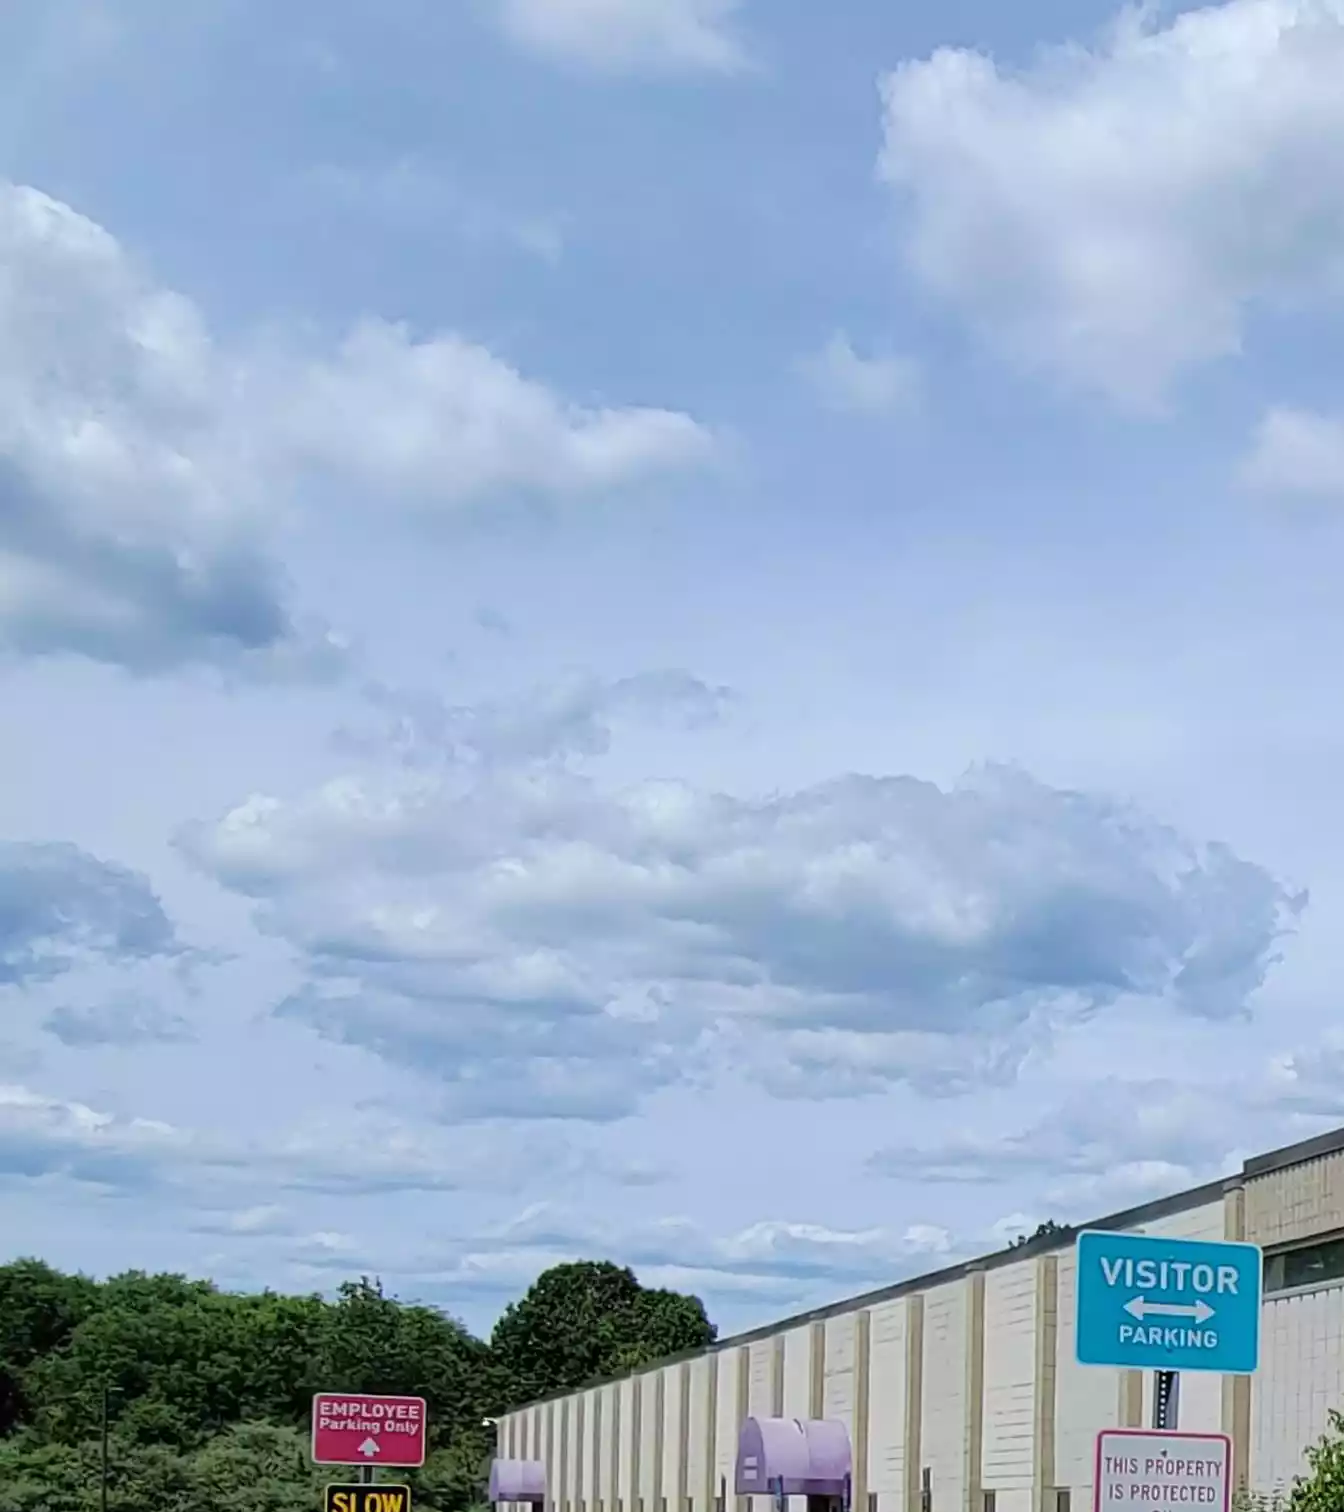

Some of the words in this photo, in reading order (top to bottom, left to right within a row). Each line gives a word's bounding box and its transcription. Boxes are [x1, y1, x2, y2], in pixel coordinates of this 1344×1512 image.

[1100, 1257, 1239, 1295] VISITOR
[1119, 1324, 1219, 1349] PARKING
[319, 1402, 420, 1419] EMPLOYEE
[319, 1418, 380, 1433] Parking
[384, 1420, 419, 1435] Only
[1104, 1457, 1139, 1475] THIS
[1144, 1458, 1223, 1477] PROPERTY
[1108, 1484, 1123, 1501] IS
[1130, 1485, 1216, 1503] PROTECTED
